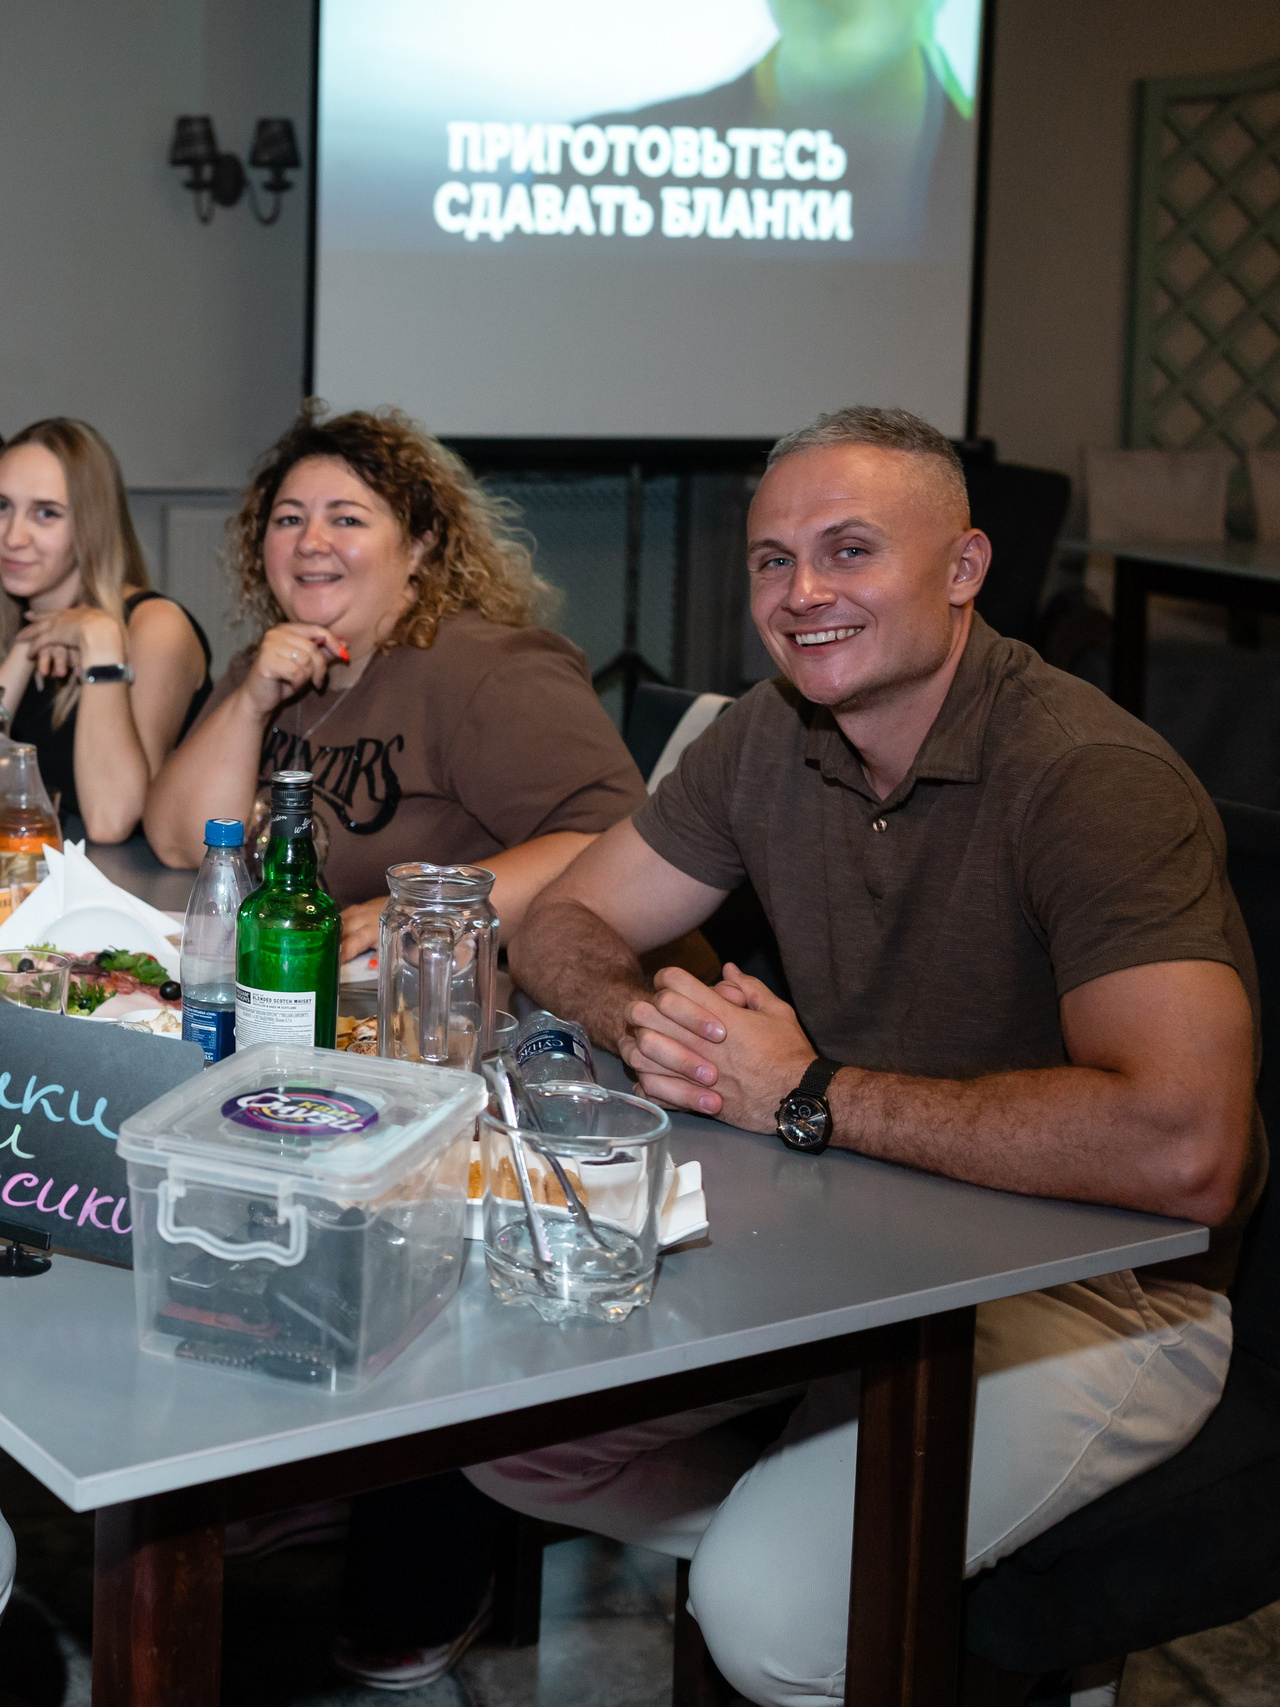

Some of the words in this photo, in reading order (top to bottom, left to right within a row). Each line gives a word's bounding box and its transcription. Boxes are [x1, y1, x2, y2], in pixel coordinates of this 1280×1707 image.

[446, 121, 848, 182] ПРИГОТОВЬТЕСЬ
[433, 180, 655, 242] СДАВАТЬ
[660, 186, 854, 241] БЛАНКИ
